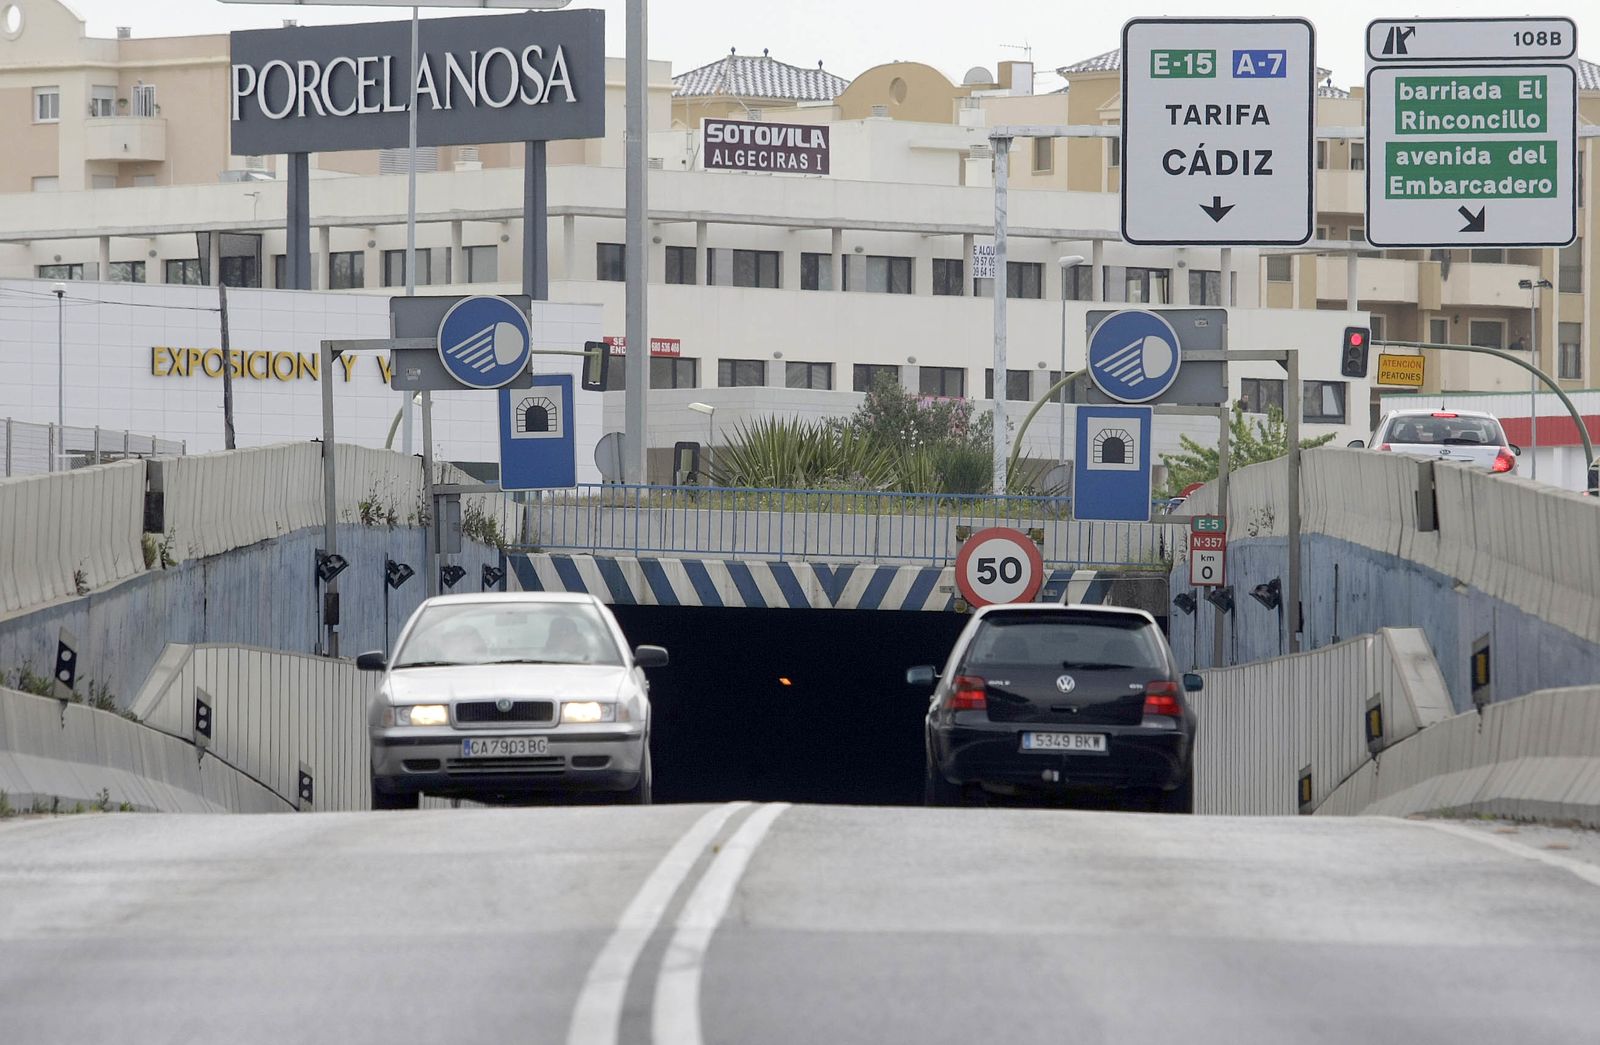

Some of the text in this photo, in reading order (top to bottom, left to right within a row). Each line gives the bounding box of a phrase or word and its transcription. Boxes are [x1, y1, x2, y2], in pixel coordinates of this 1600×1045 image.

[1513, 31, 1562, 46] 108B
[1154, 53, 1283, 75] E-15 A-7
[231, 44, 577, 121] PORCELANOSA
[1399, 80, 1543, 100] barriada El
[1165, 104, 1270, 126] TARIFA
[1401, 109, 1541, 130] Rinconcillo
[706, 123, 827, 149] SOTOVILA
[712, 149, 809, 169] ALGECIRAS
[1162, 142, 1273, 176] CÁDIZ
[1396, 145, 1547, 166] avenida del
[1389, 176, 1552, 195] Embarcadero
[979, 245, 995, 256] ALQU
[610, 346, 626, 354] END
[613, 337, 624, 346] SE
[151, 346, 320, 381] EXPOSICION
[339, 354, 357, 382] Y
[1381, 371, 1421, 381] PEATONES
[1198, 519, 1219, 530] E-5
[1193, 537, 1223, 548] N-357
[1200, 554, 1215, 562] km
[977, 556, 1022, 585] 50
[1035, 734, 1100, 749] 5349 BKW
